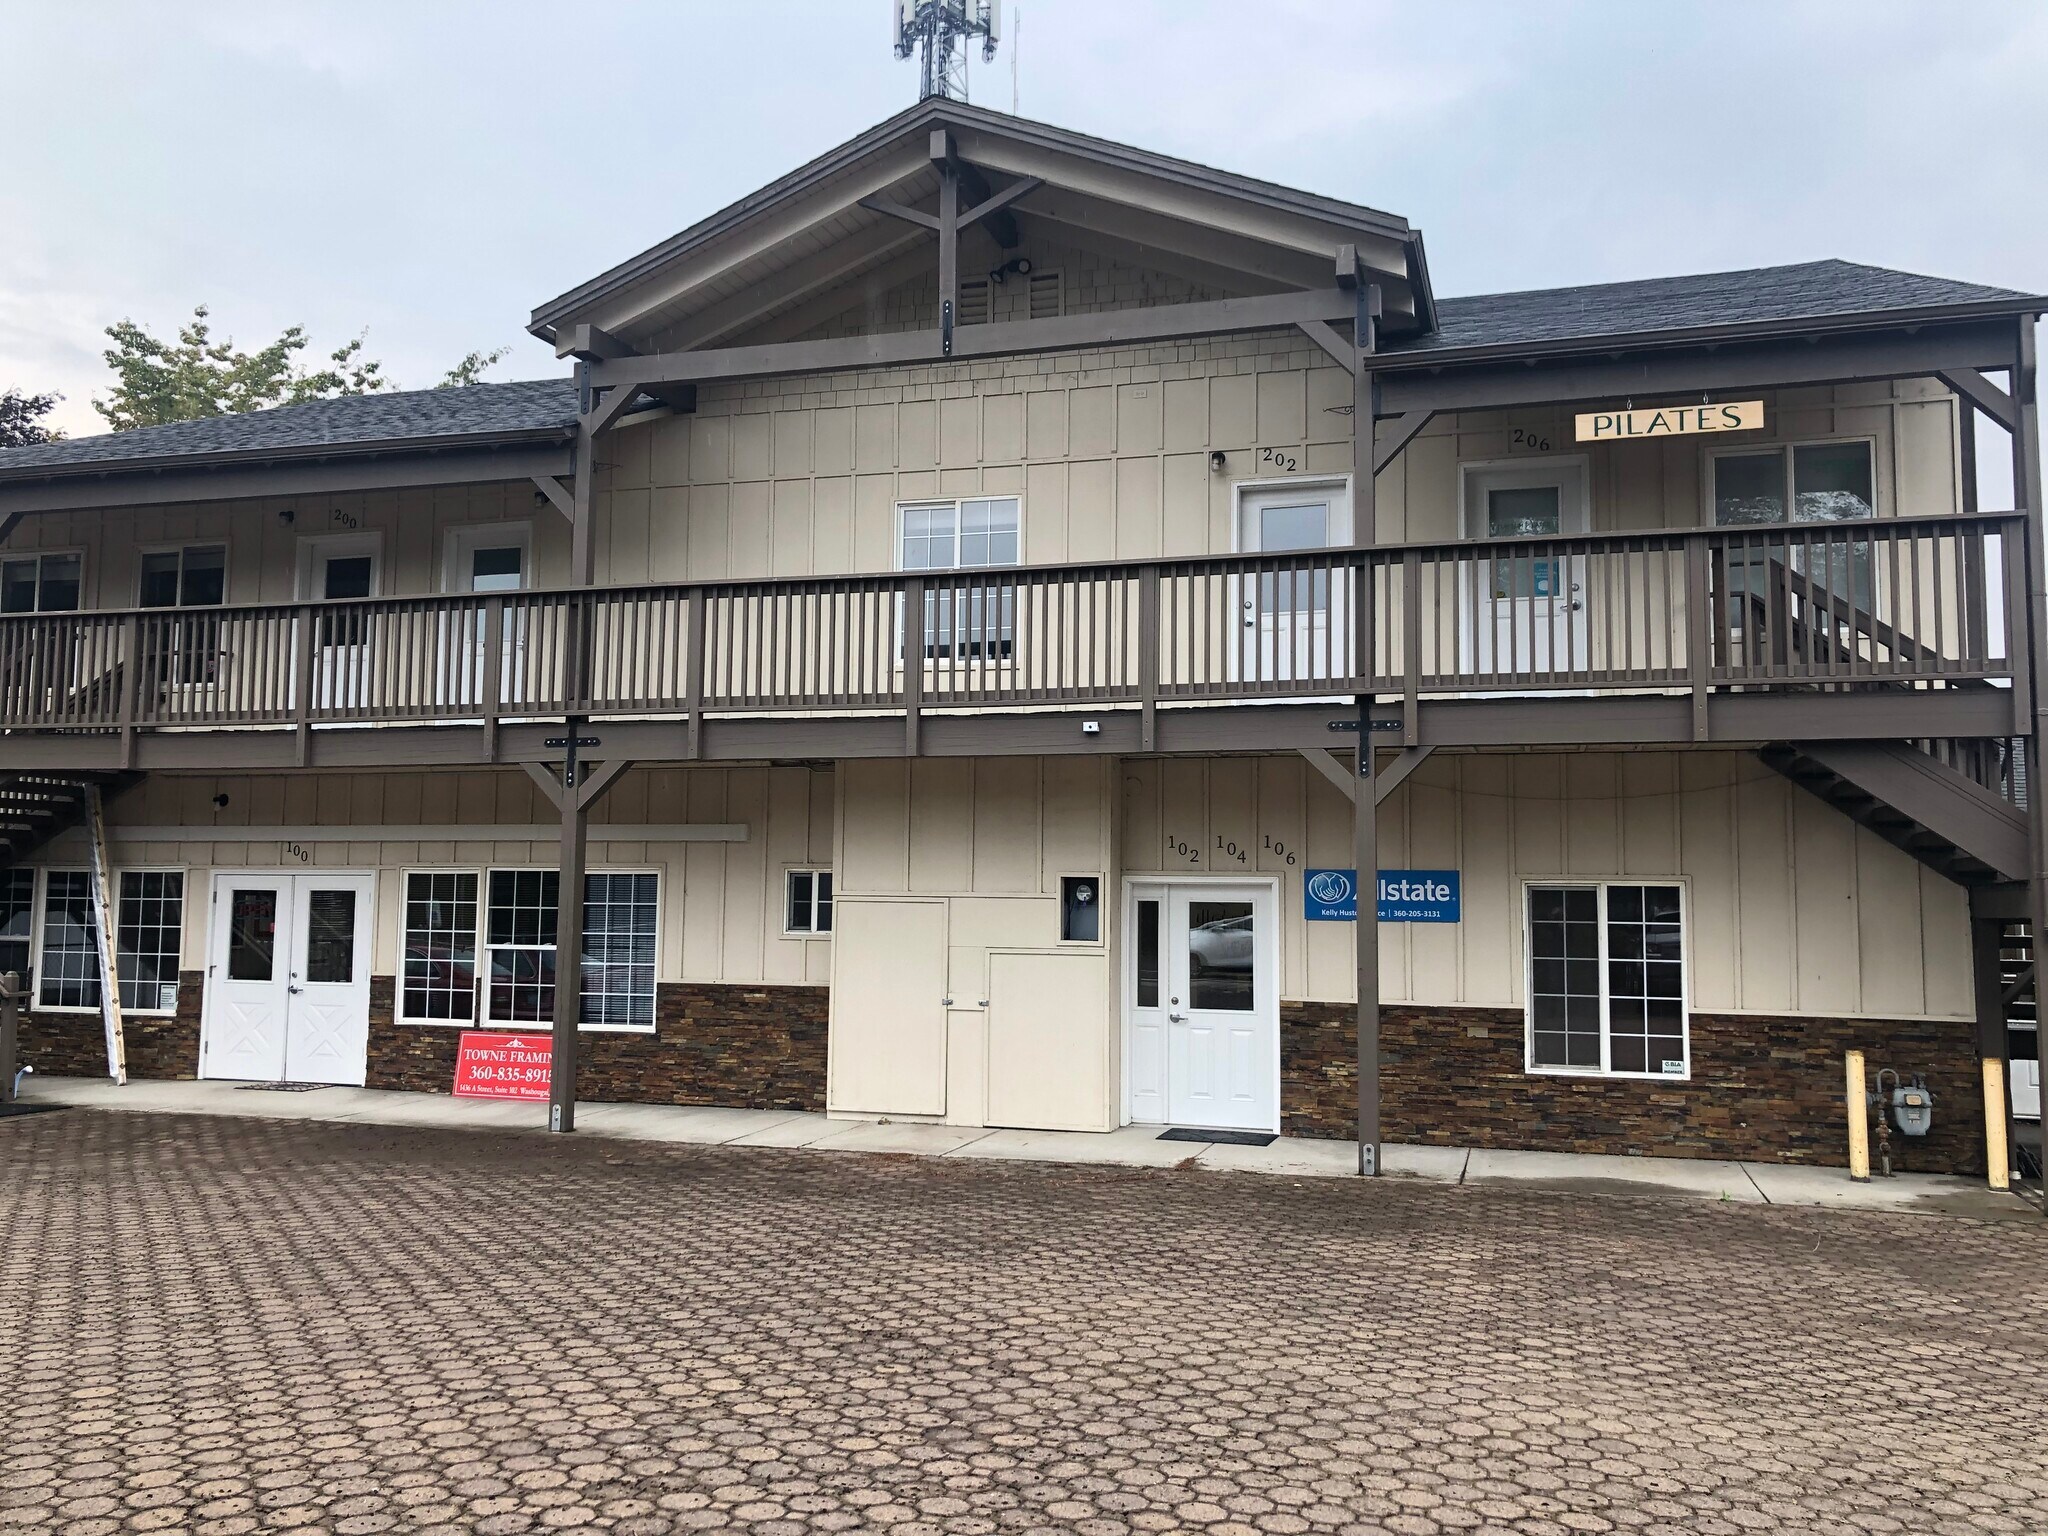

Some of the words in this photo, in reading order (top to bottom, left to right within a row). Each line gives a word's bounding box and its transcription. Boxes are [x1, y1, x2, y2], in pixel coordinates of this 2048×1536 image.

[1594, 405, 1742, 437] PILATES
[1513, 428, 1550, 452] 206
[1263, 447, 1296, 472] 202
[334, 508, 357, 529] 200
[286, 840, 308, 862] 100
[1168, 835, 1199, 863] 102
[1216, 835, 1247, 864] 104
[1264, 834, 1296, 866] 106
[1353, 879, 1450, 902] lstate
[1321, 908, 1338, 917] Kelly
[1393, 909, 1441, 918] 360-205-3131
[464, 1048, 508, 1063] TOWNE
